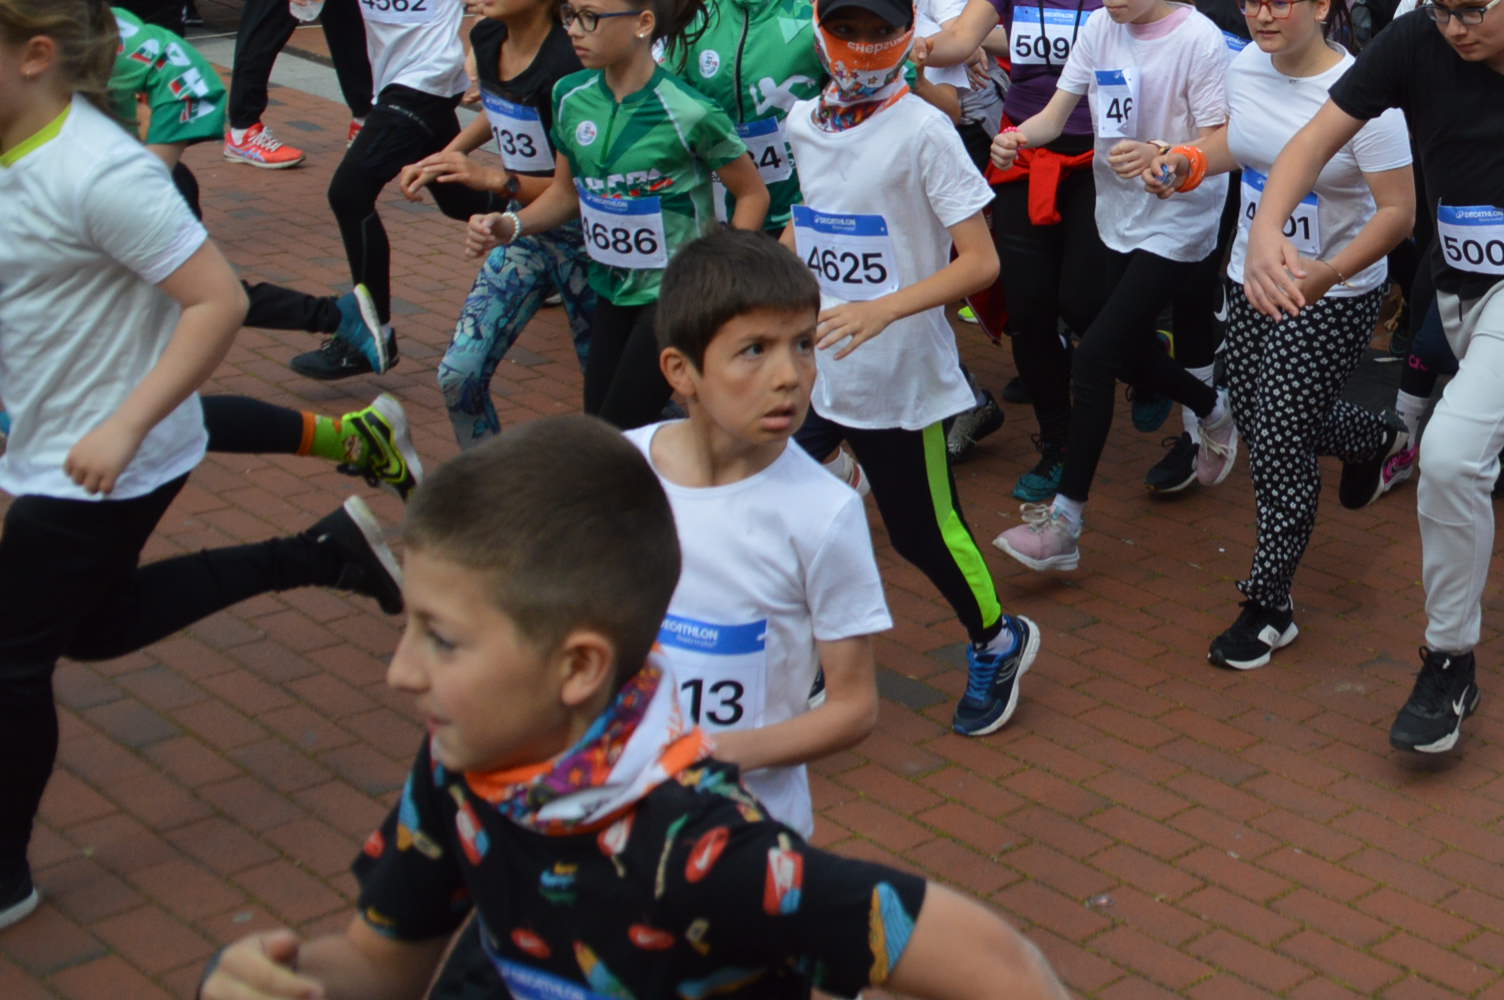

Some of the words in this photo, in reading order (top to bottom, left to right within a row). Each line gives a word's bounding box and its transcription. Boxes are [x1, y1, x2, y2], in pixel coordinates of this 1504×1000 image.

[1015, 34, 1070, 60] 509
[582, 217, 658, 256] 4686
[807, 246, 888, 284] 4625
